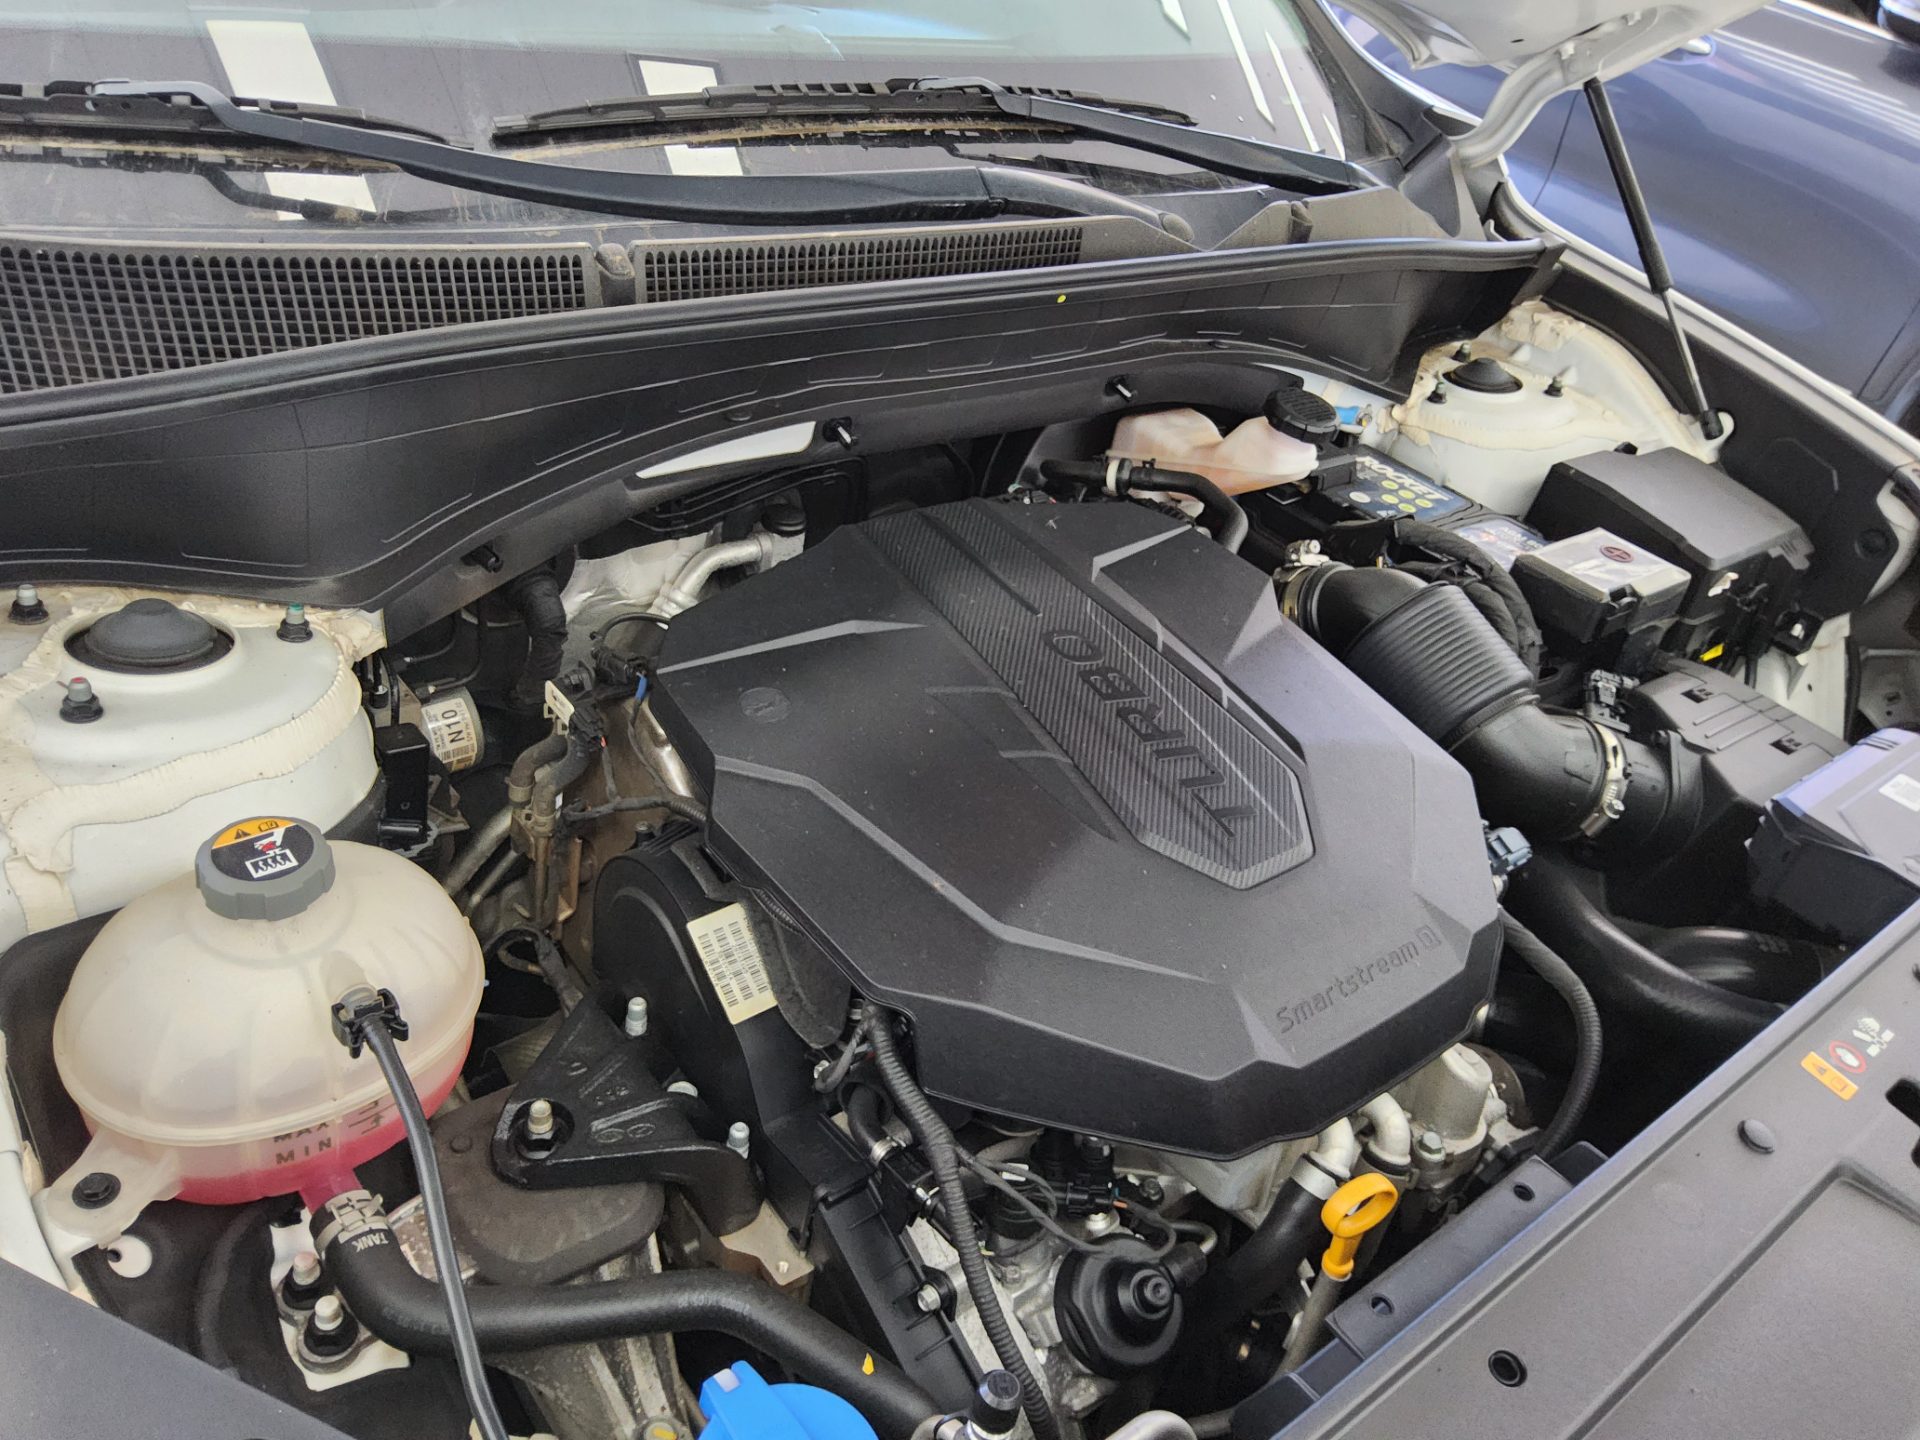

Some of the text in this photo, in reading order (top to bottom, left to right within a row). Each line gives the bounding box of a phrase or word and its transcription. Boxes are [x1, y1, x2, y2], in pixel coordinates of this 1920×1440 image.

[1355, 455, 1450, 500] ROCKET
[441, 709, 465, 744] N10
[1041, 629, 1259, 837] TURBO
[1276, 941, 1419, 1034] Smartstream
[275, 1137, 332, 1165] MIN
[352, 1231, 389, 1253] TANK
